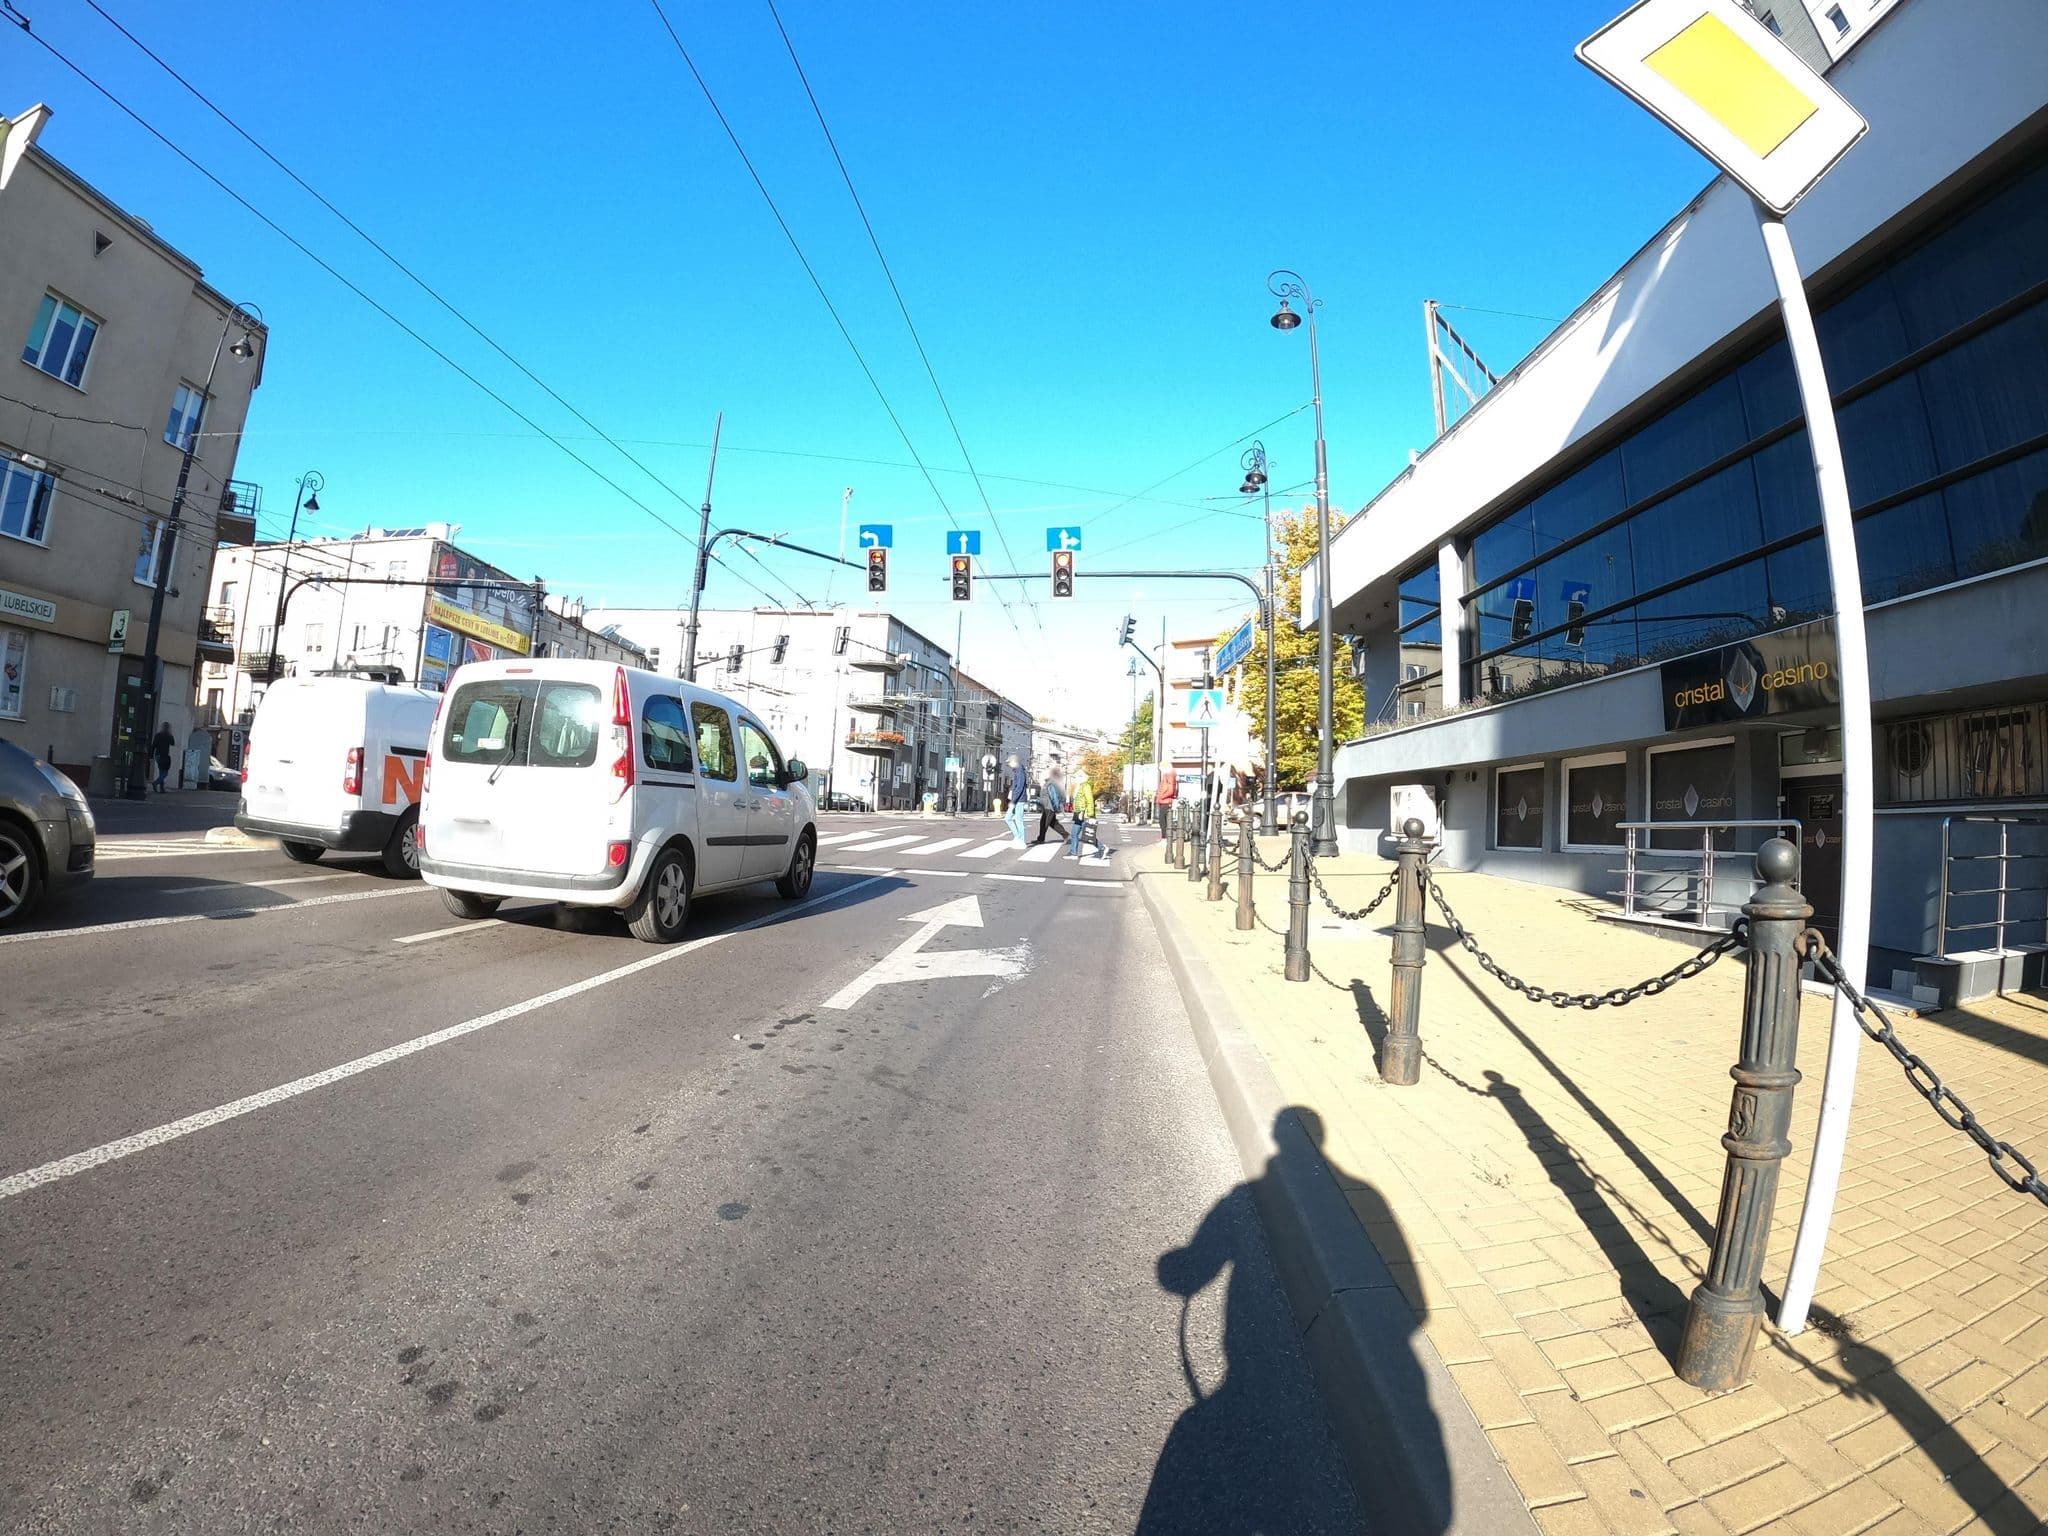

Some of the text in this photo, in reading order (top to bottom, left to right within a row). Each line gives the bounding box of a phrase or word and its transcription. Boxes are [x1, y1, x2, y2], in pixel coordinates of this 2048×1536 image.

[4, 595, 53, 618] LUBELSKIEJ
[1675, 661, 1828, 708] cristal casino
